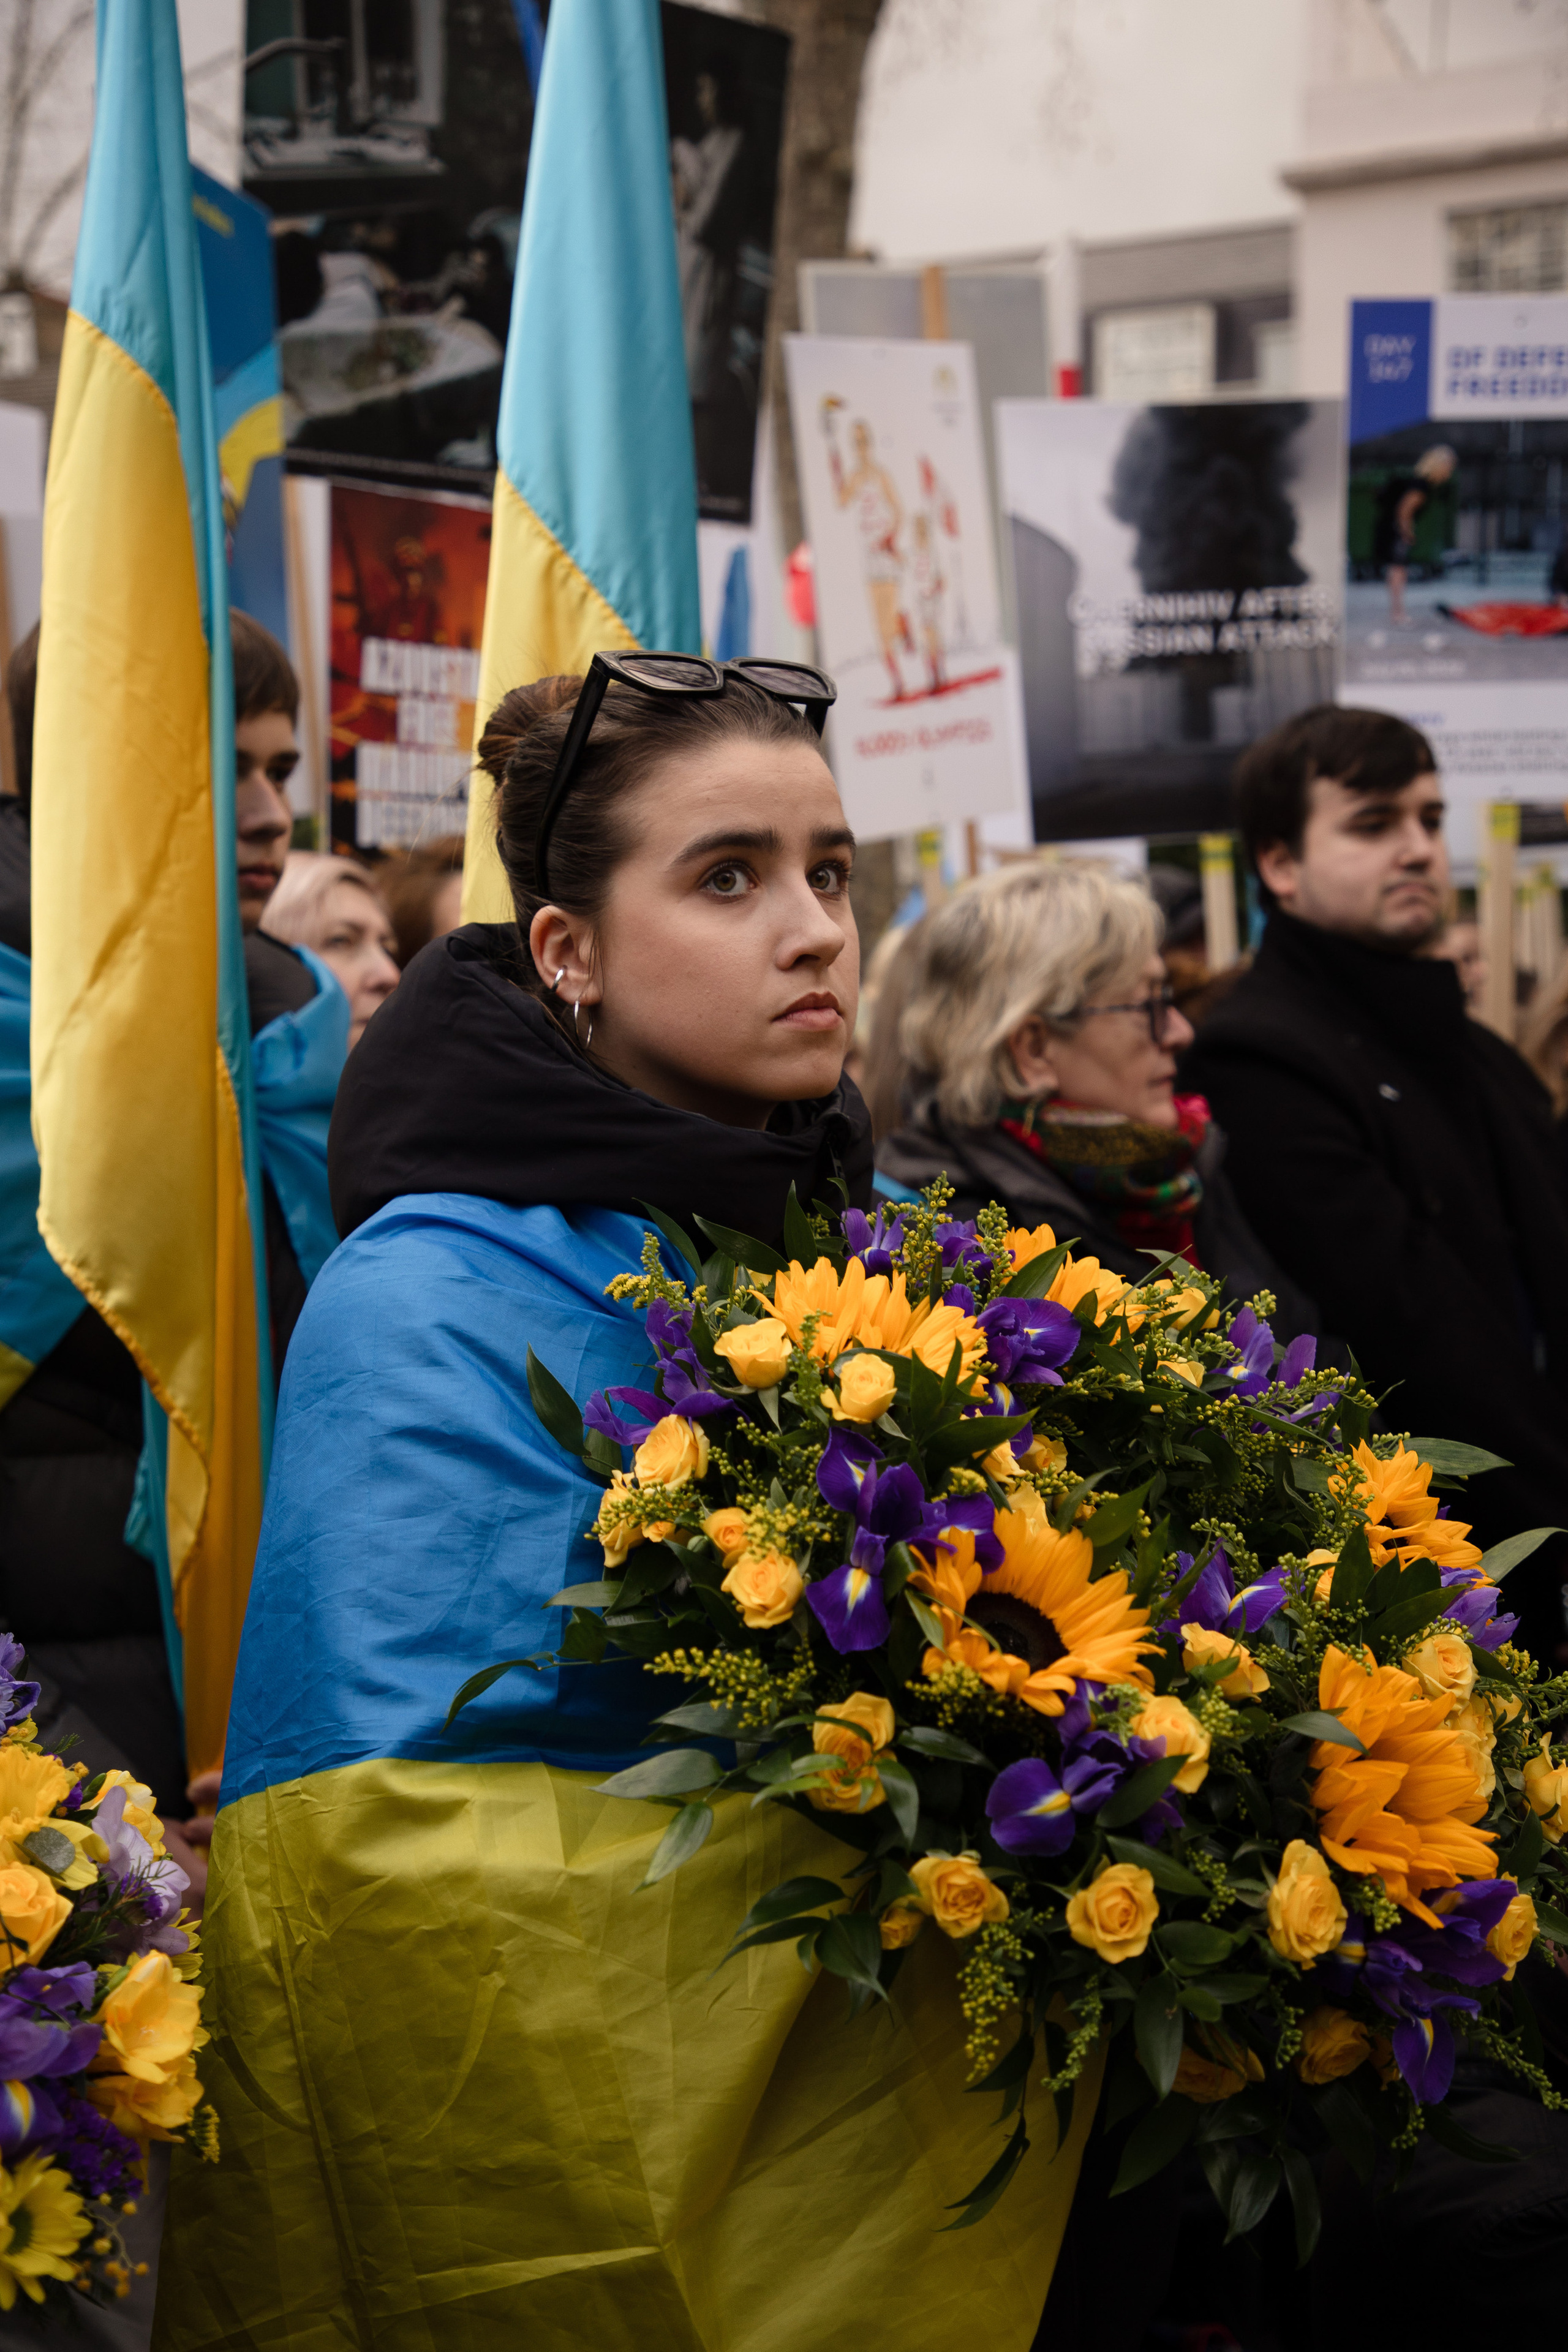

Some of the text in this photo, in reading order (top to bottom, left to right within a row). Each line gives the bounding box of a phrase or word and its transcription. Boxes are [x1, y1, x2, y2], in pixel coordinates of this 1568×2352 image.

[1448, 345, 1487, 370] OF
[1447, 374, 1568, 399] FREEDO
[1069, 586, 1330, 622] CERNIHIV AFTER
[1218, 619, 1338, 652] ATTACK
